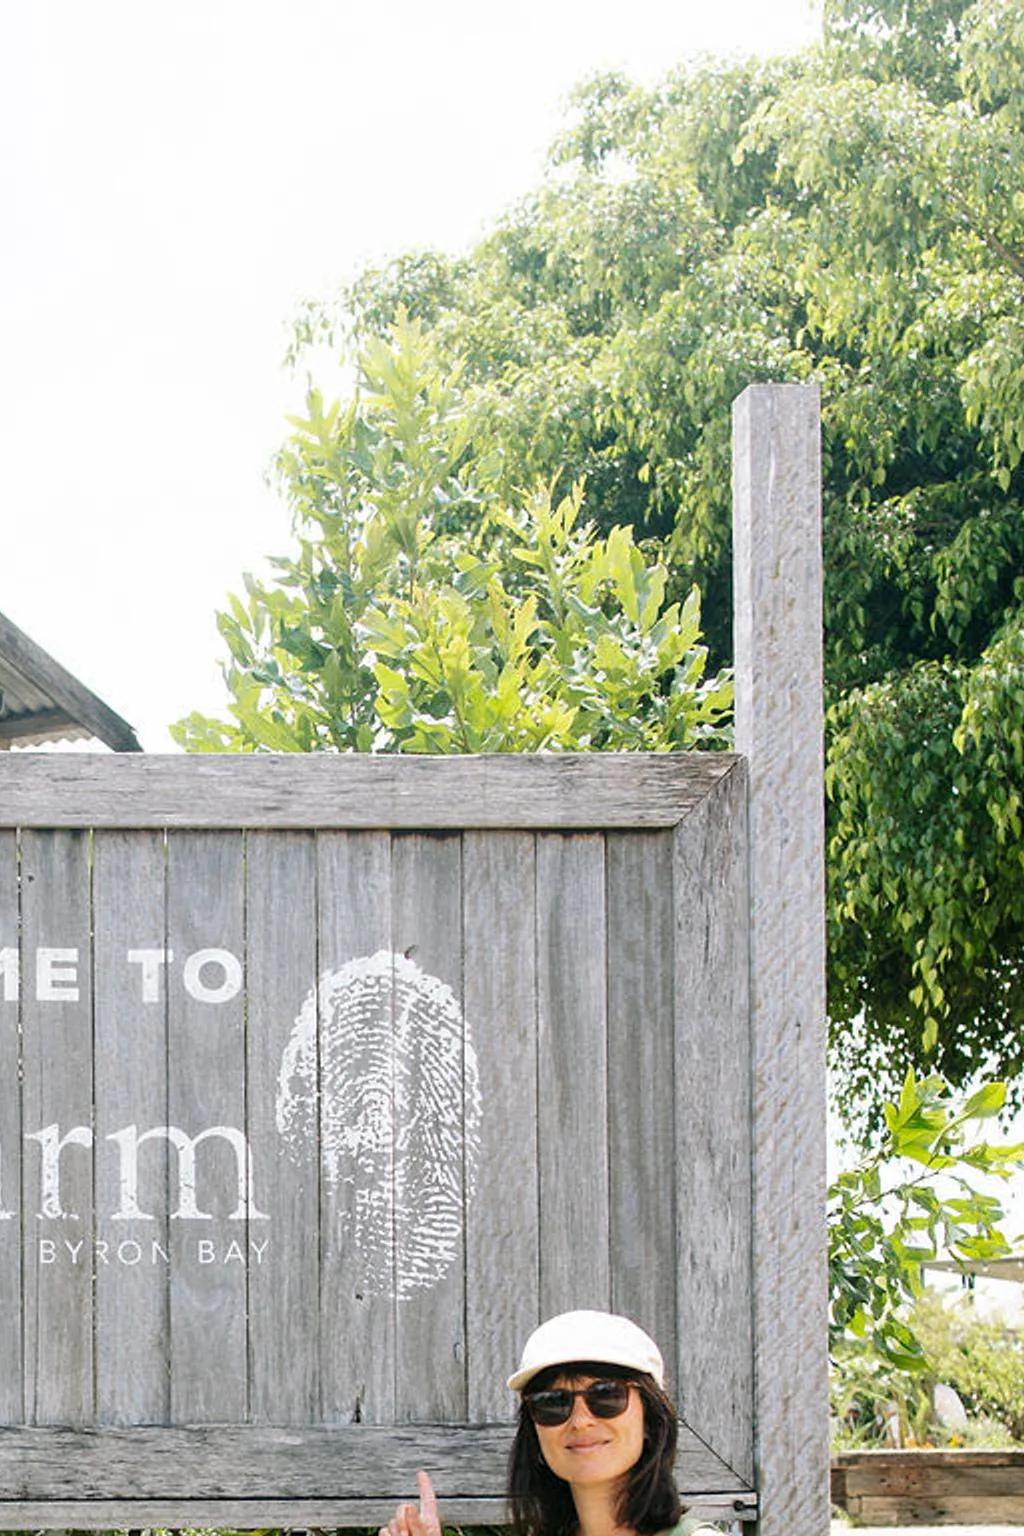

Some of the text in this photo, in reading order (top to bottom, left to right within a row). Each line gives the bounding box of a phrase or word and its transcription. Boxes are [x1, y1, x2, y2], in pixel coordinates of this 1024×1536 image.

[127, 948, 244, 1003] TO
[39, 1240, 269, 1264] BYRON BAY
